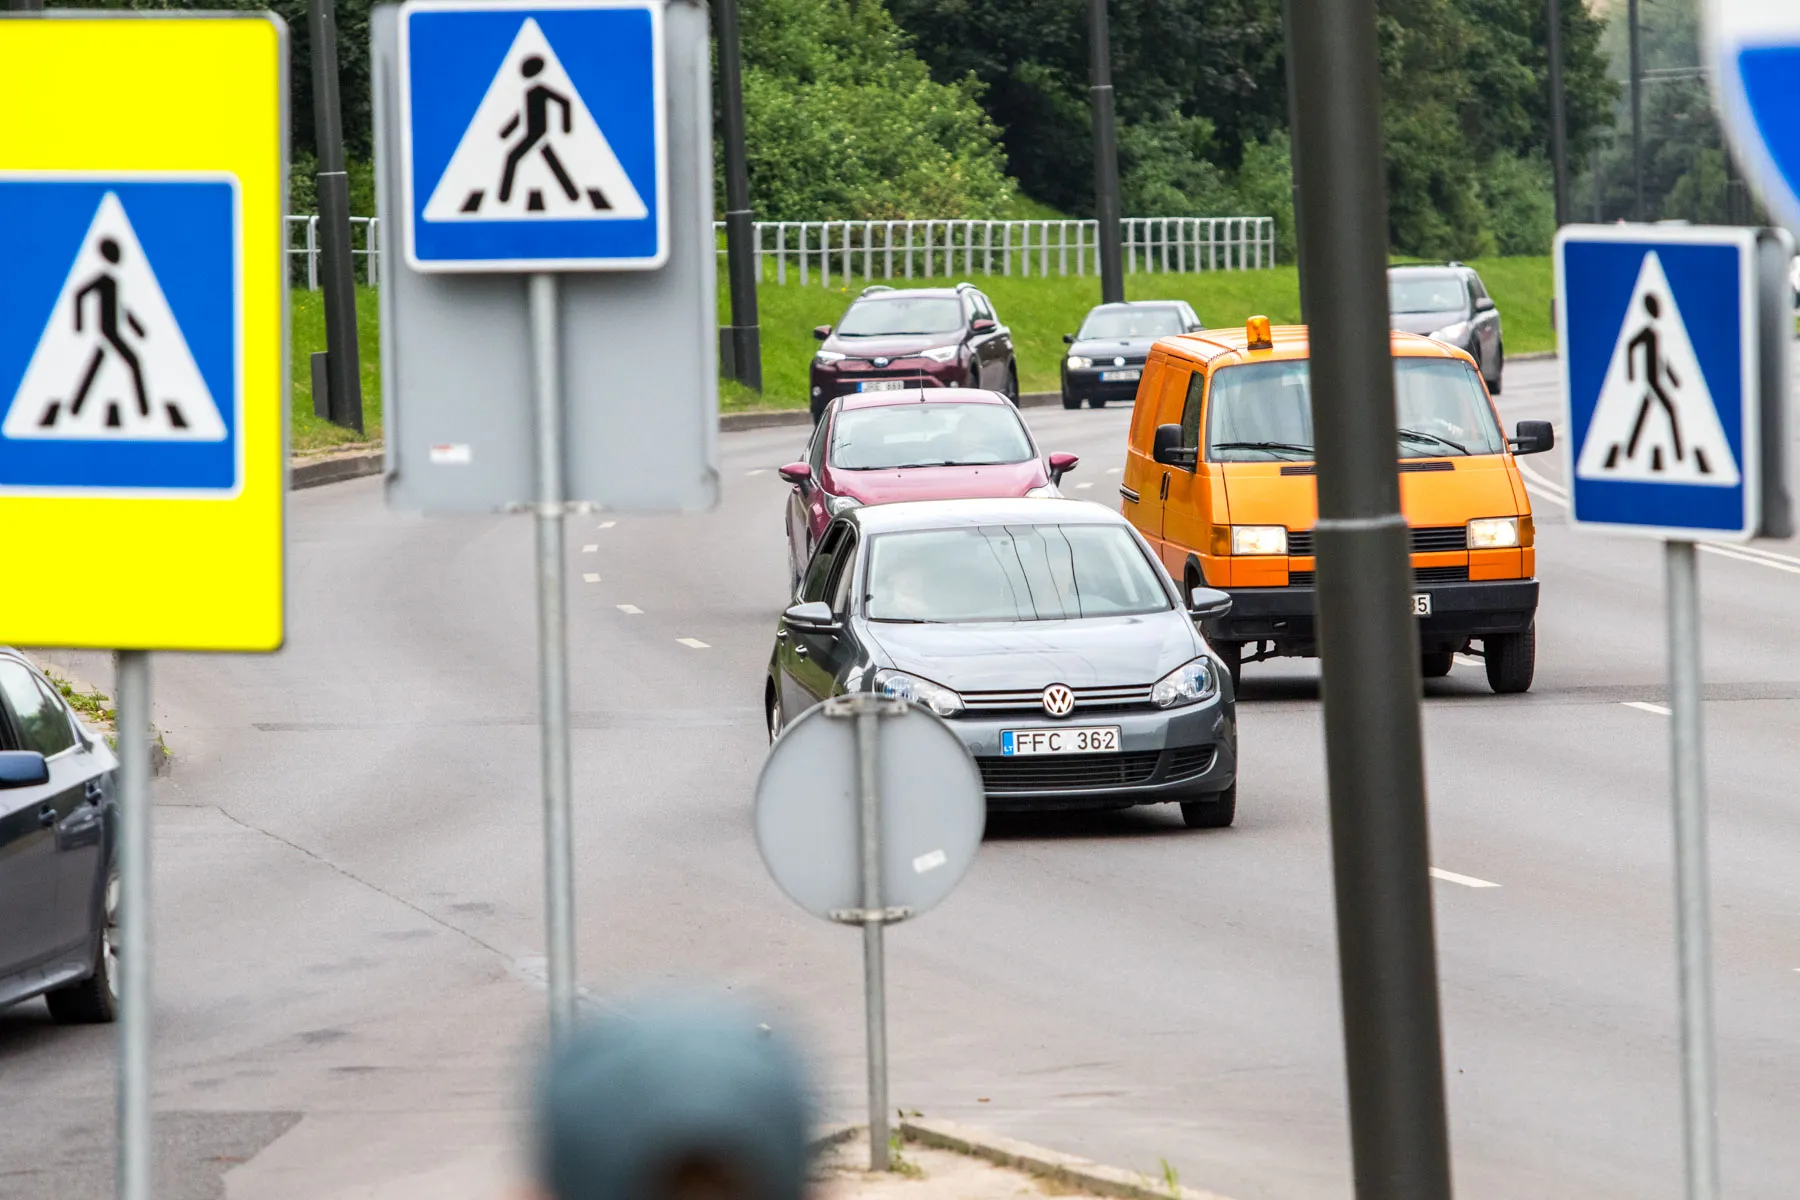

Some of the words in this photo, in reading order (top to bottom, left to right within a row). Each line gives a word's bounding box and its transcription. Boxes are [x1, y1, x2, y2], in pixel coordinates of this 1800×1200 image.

[1044, 685, 1074, 716] VW
[1003, 745, 1014, 753] LT
[1016, 733, 1061, 752] FFC
[1077, 731, 1115, 750] 362
